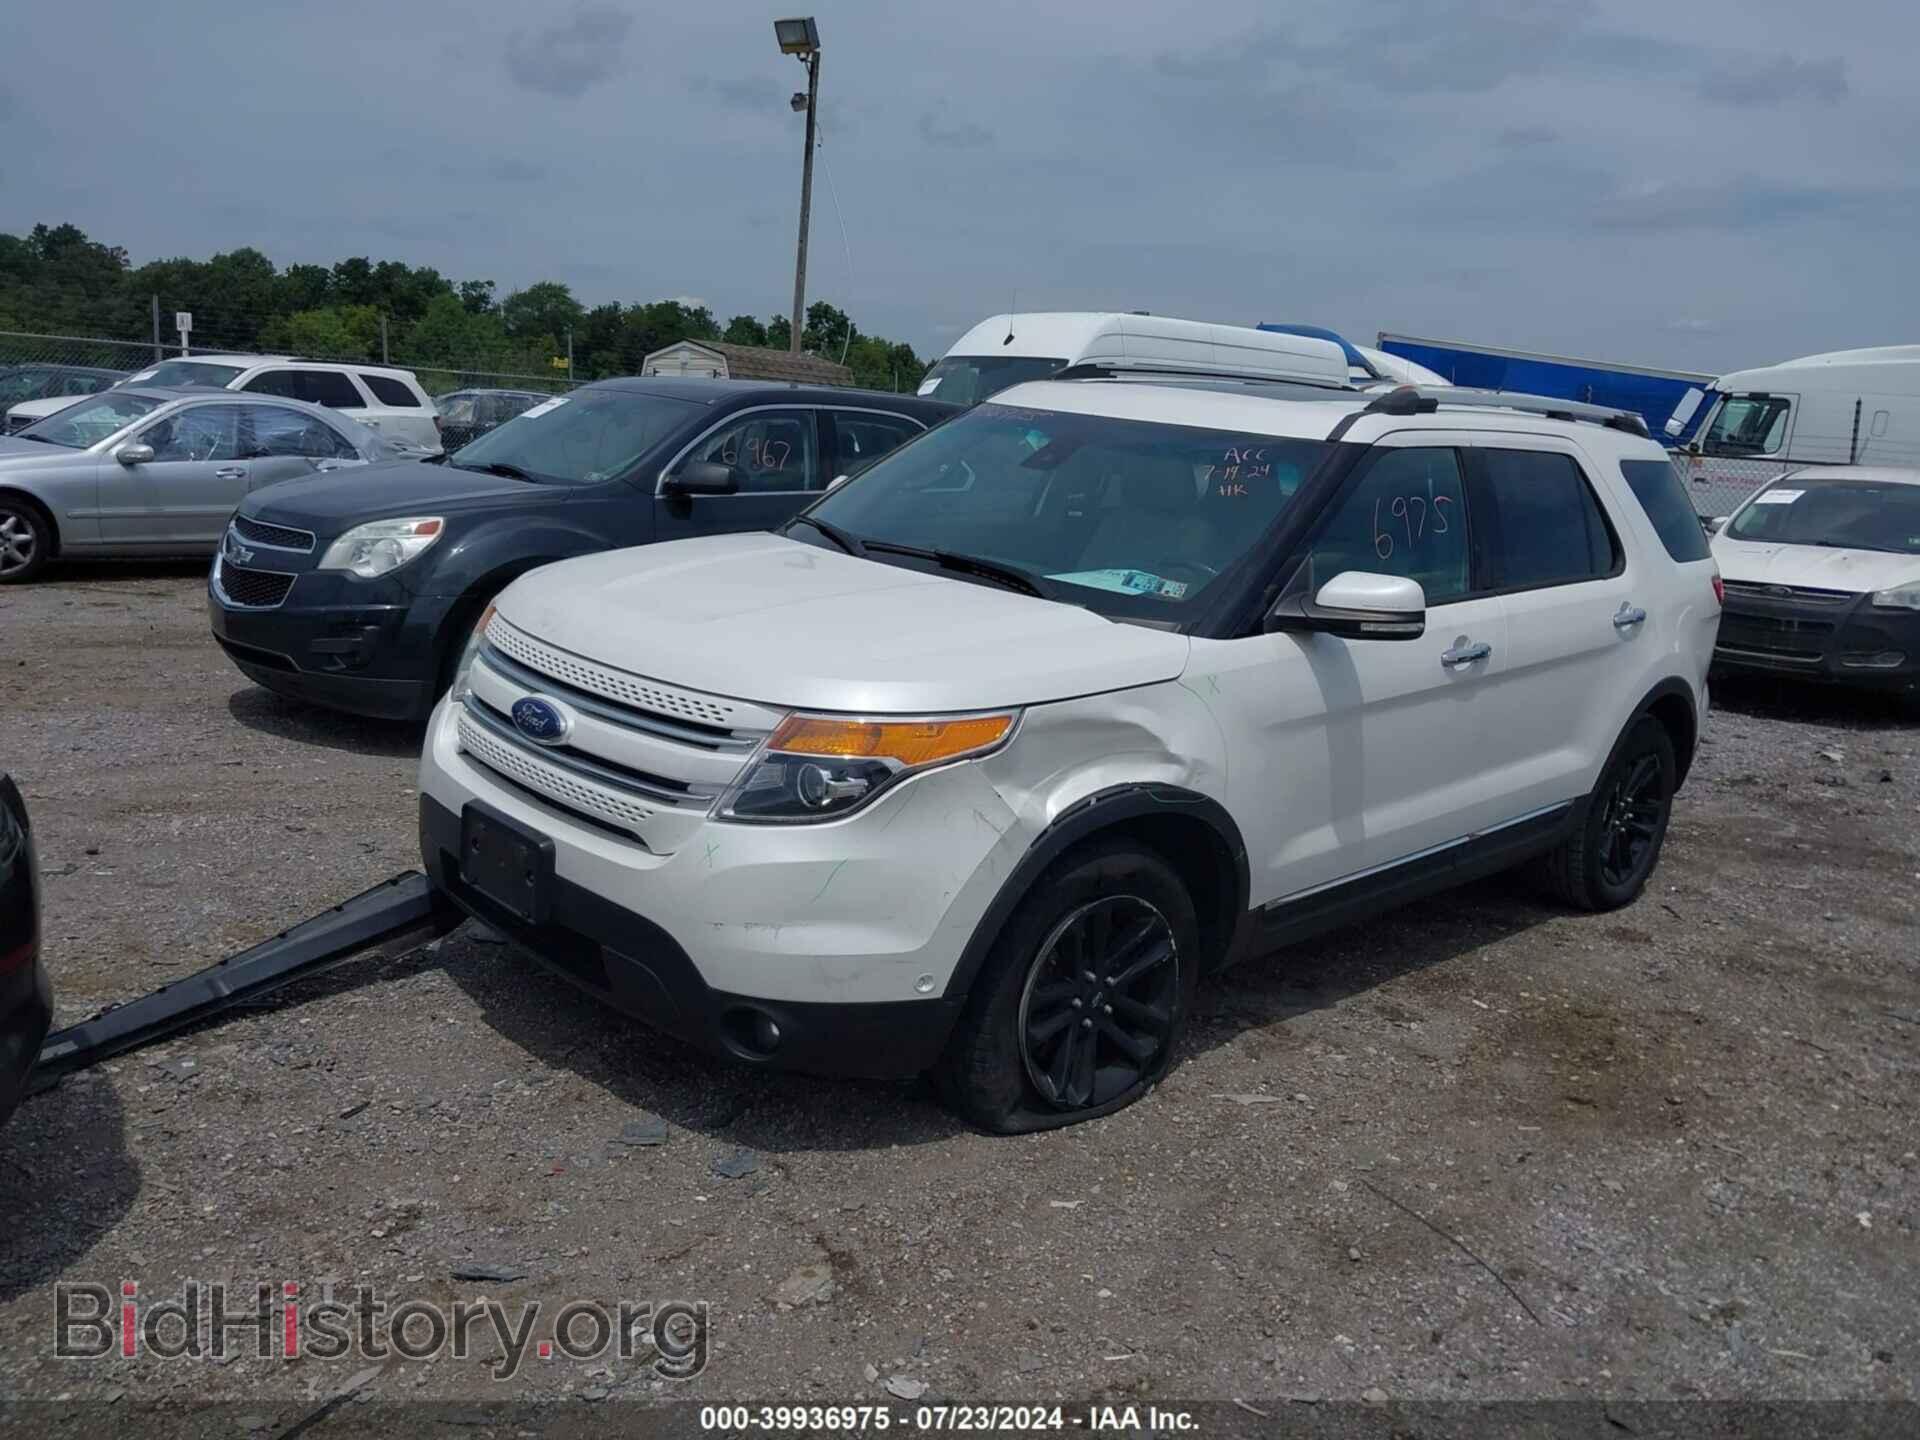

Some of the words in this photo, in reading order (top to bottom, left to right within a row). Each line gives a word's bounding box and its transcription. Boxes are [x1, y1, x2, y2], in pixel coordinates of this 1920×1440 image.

[1223, 447, 1268, 464] ACC
[1374, 495, 1454, 560] 6975
[516, 702, 550, 731] Ford
